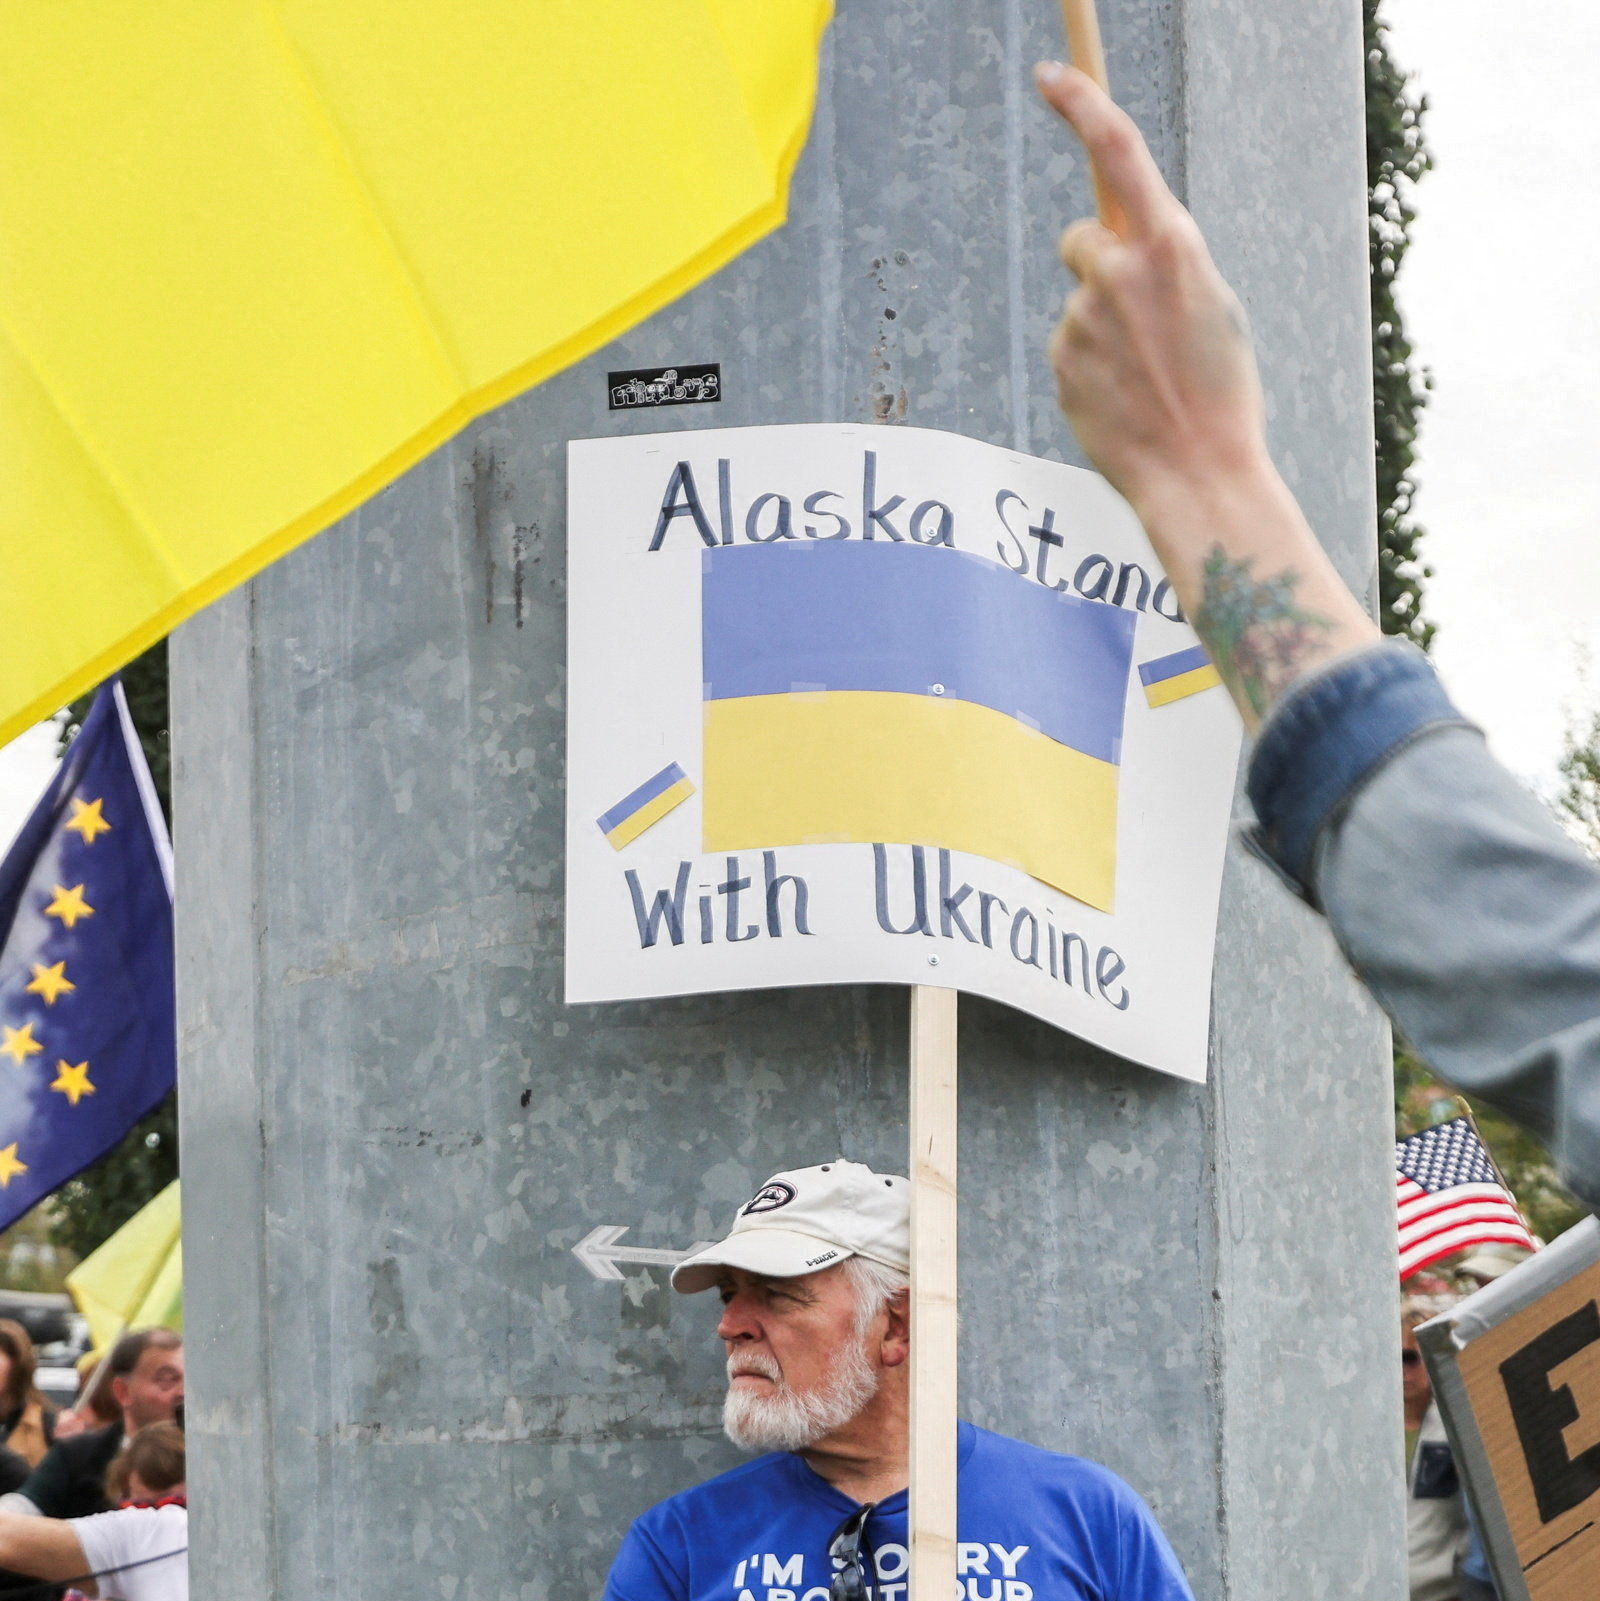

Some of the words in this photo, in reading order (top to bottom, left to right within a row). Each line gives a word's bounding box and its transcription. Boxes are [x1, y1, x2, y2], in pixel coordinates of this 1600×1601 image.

[648, 449, 957, 552] Alaska
[623, 850, 815, 949] With
[872, 842, 1130, 1012] Ukraine
[732, 1553, 804, 1588] I'M
[829, 1541, 1030, 1581] SORY
